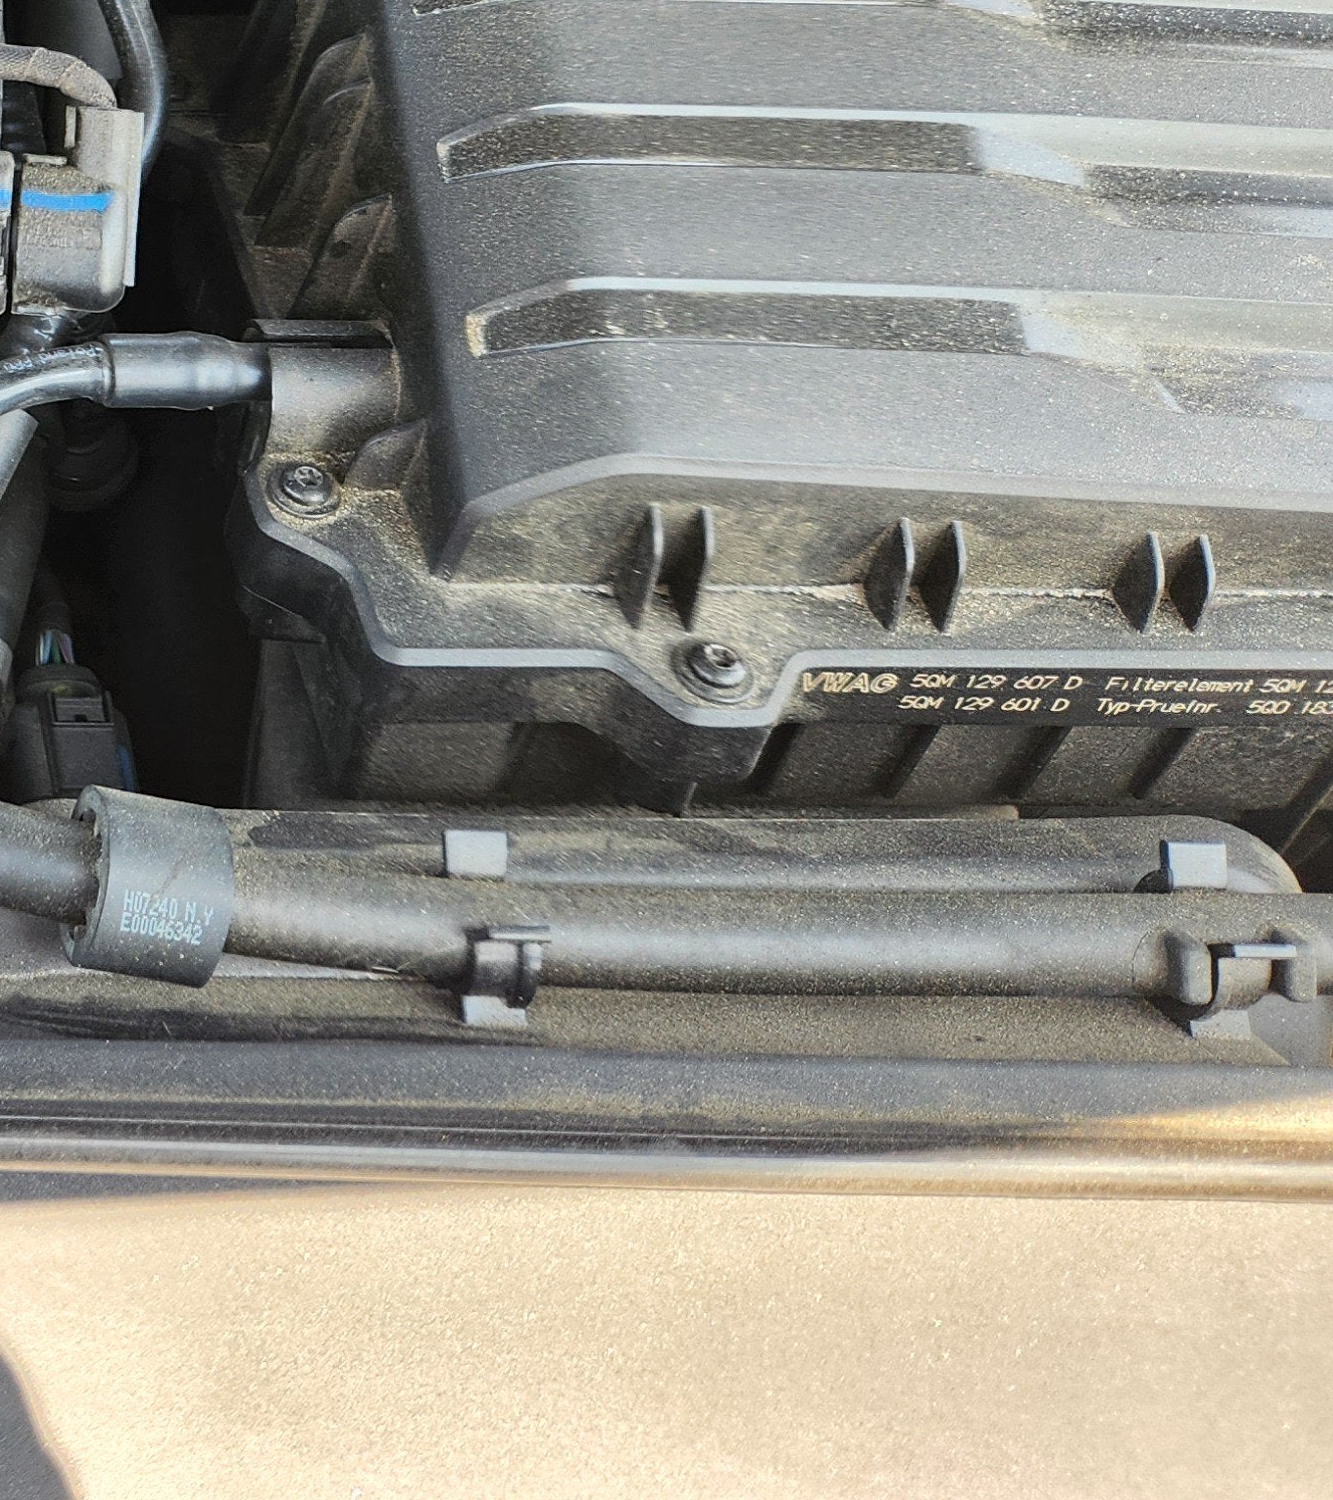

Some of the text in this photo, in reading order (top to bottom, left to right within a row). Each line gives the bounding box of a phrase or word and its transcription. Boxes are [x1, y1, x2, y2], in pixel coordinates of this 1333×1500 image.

[802, 671, 900, 693] VWAG
[909, 673, 957, 689] 5QM
[966, 674, 1007, 689] 129
[1013, 675, 1060, 690] 607
[1063, 676, 1084, 691] D
[1104, 676, 1255, 693] Filterelement
[1258, 678, 1307, 693] 5QM
[897, 695, 945, 710] 5QM
[954, 696, 995, 711] 129
[1000, 697, 1042, 712] 601
[1050, 698, 1071, 712] D
